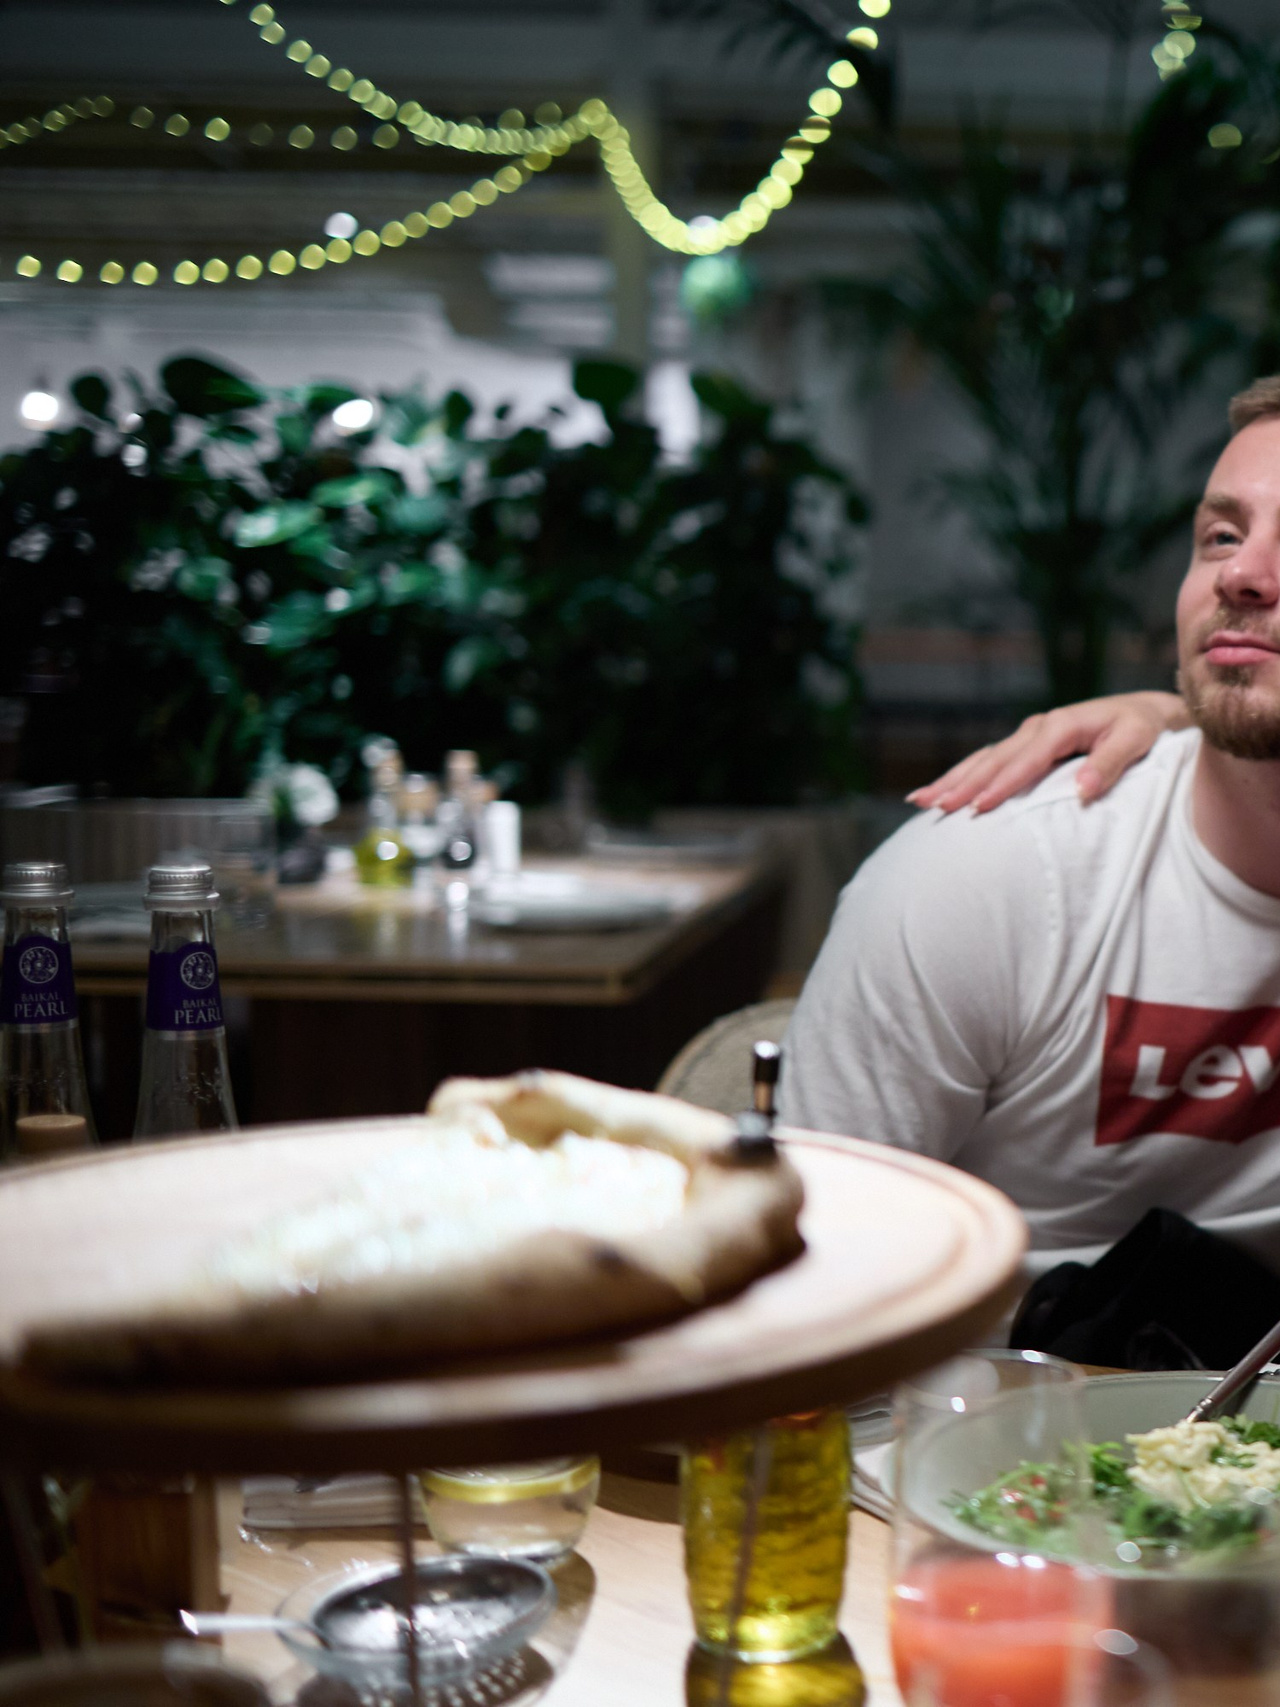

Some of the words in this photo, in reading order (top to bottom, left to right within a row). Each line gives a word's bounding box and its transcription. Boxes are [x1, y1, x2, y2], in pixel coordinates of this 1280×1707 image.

[21, 992, 60, 1002] BAIKAL
[182, 998, 217, 1009] BAIKAL
[14, 1000, 69, 1018] PEARL
[174, 1007, 222, 1024] PEARL
